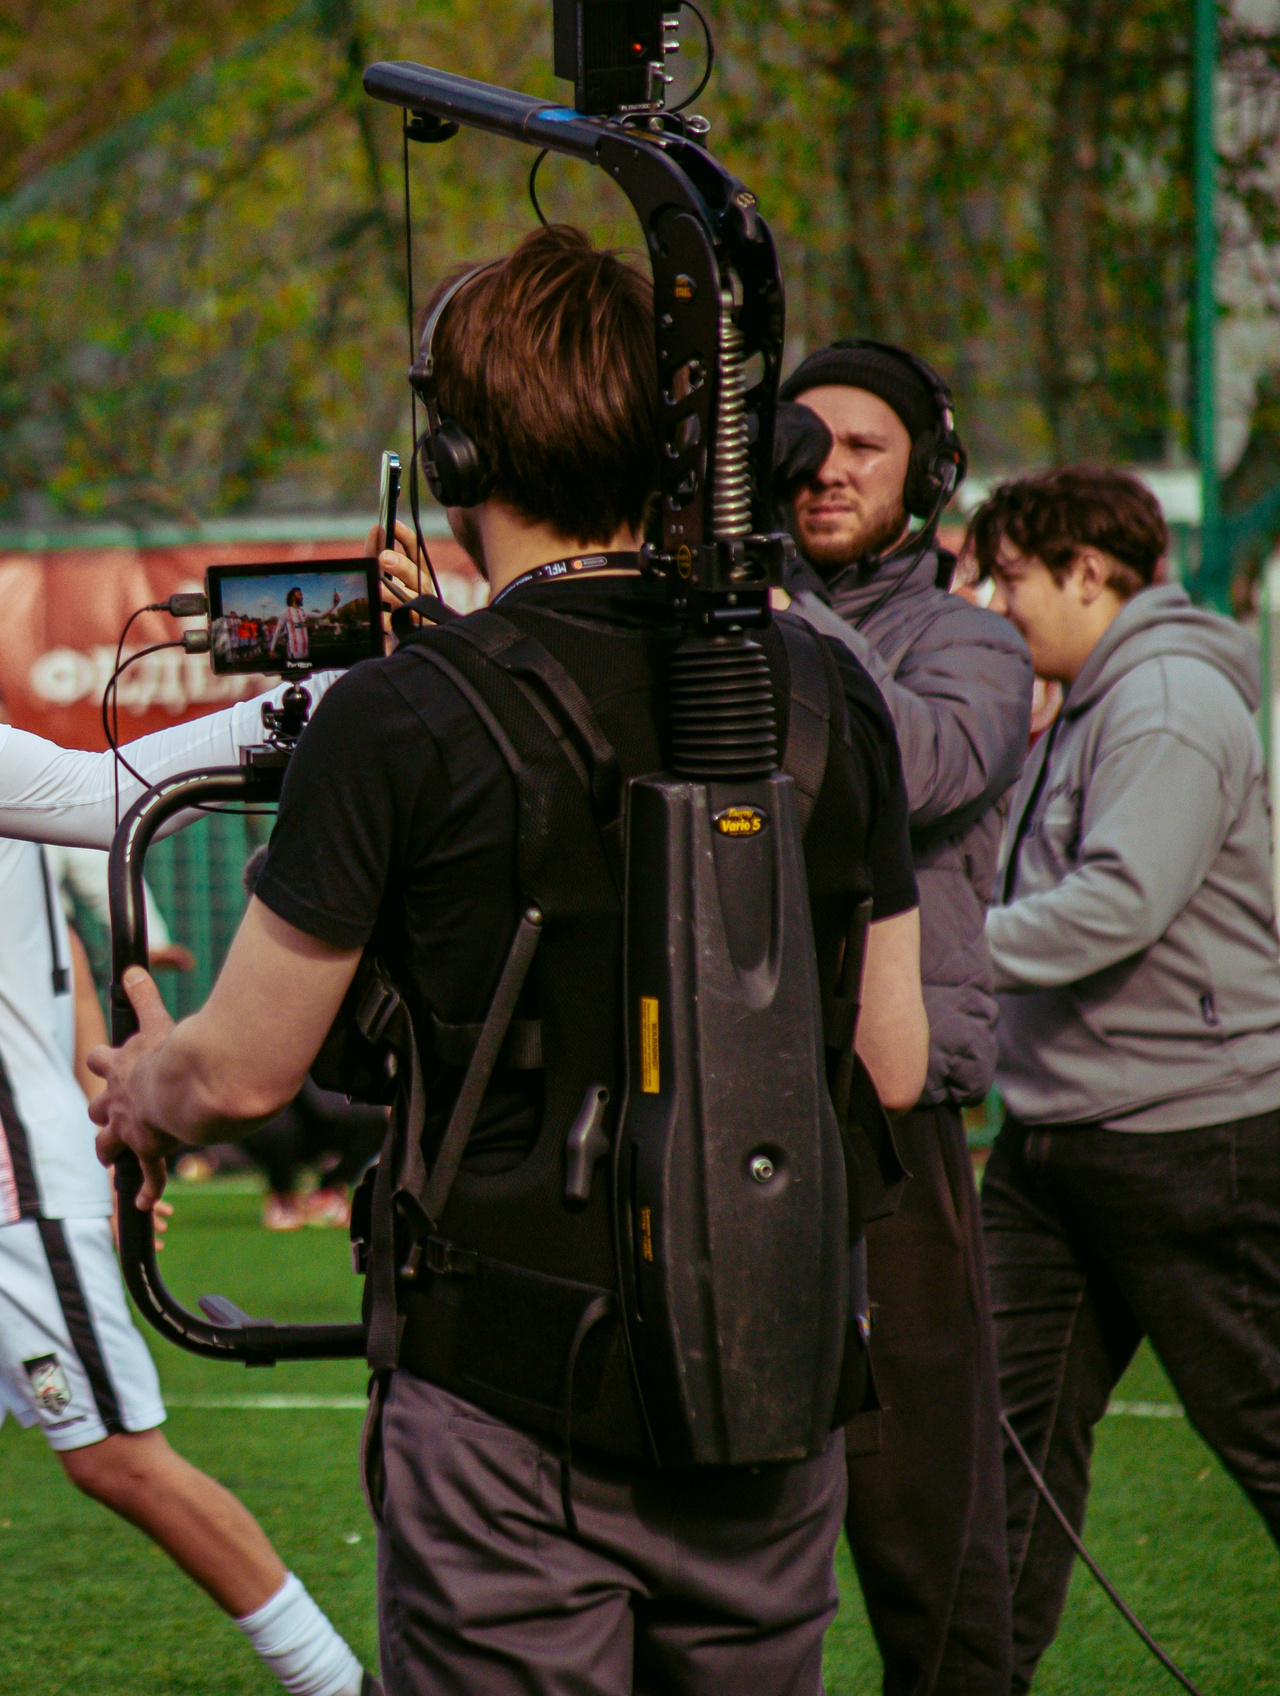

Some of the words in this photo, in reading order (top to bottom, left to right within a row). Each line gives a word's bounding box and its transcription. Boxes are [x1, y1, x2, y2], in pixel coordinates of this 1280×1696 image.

[545, 561, 567, 576] MFL
[721, 818, 750, 833] Vario
[752, 818, 762, 831] 5
